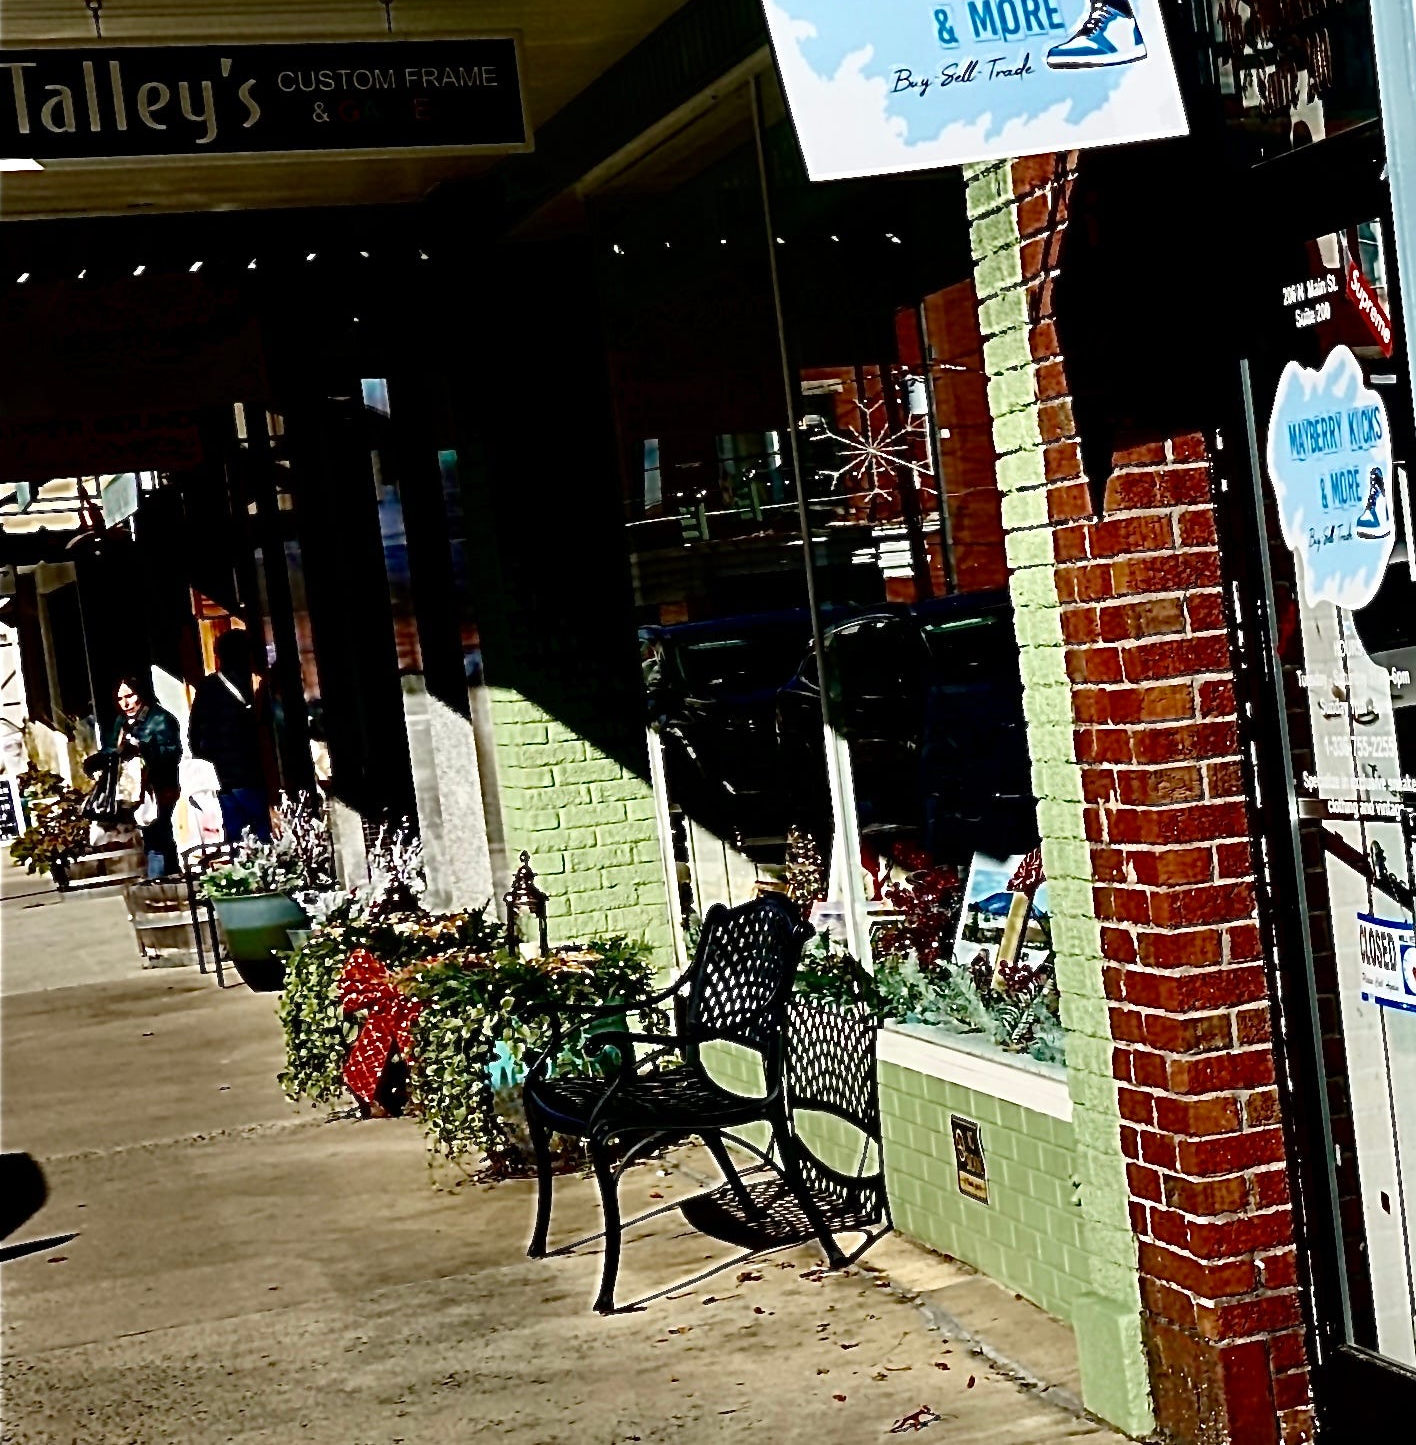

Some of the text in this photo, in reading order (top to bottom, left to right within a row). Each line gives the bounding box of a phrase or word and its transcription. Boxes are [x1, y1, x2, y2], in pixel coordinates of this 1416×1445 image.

[934, 8, 959, 45] &
[0, 58, 499, 144] Talley's CUSTOM FRAME
[311, 101, 330, 123] &
[1350, 269, 1391, 344] Supreme
[1288, 404, 1382, 457] MAYBERRY KICKS
[1330, 469, 1363, 506] MORE
[1360, 925, 1397, 972] CLOSED
